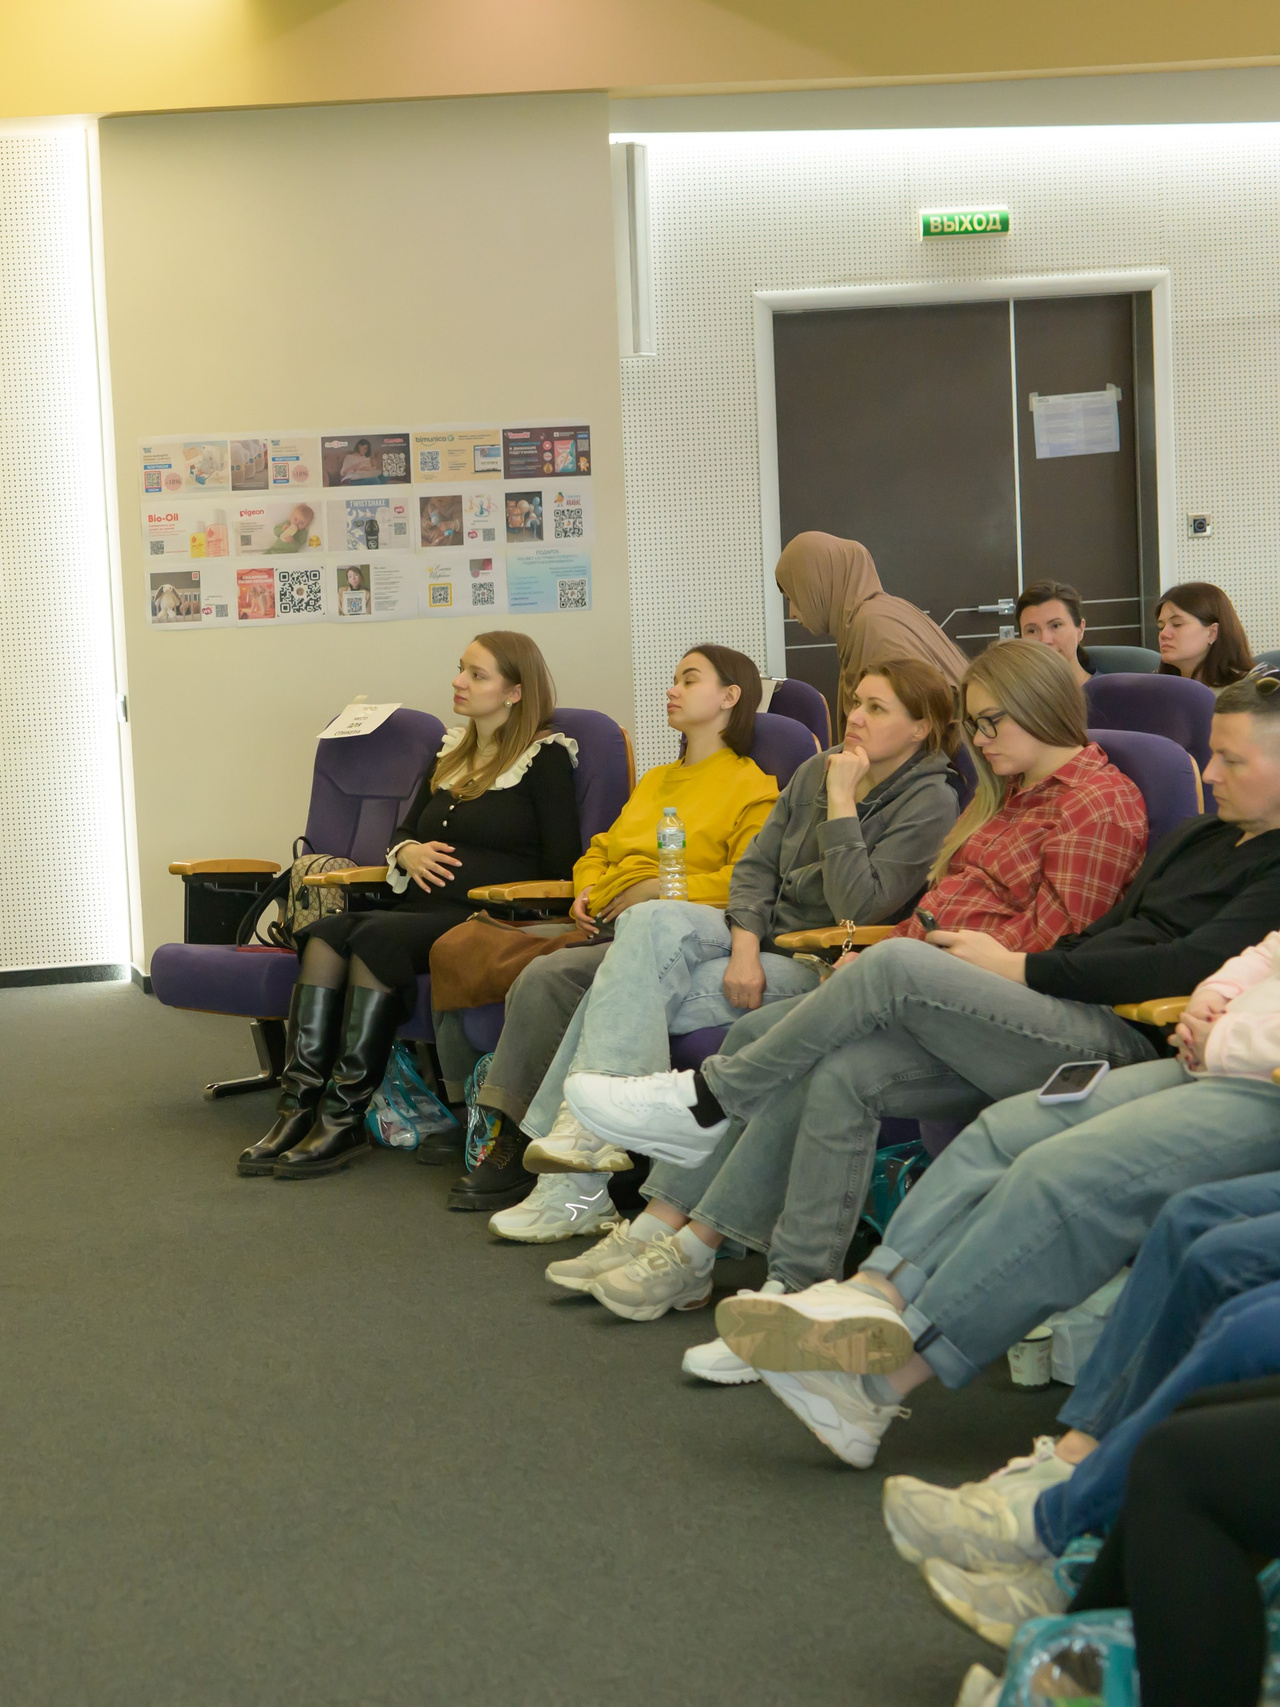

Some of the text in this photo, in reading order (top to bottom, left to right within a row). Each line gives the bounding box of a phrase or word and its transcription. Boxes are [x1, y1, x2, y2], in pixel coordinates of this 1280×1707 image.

[929, 213, 1002, 233] ВЫХОД
[147, 513, 179, 523] Bio-Oil
[239, 509, 265, 517] pigeon
